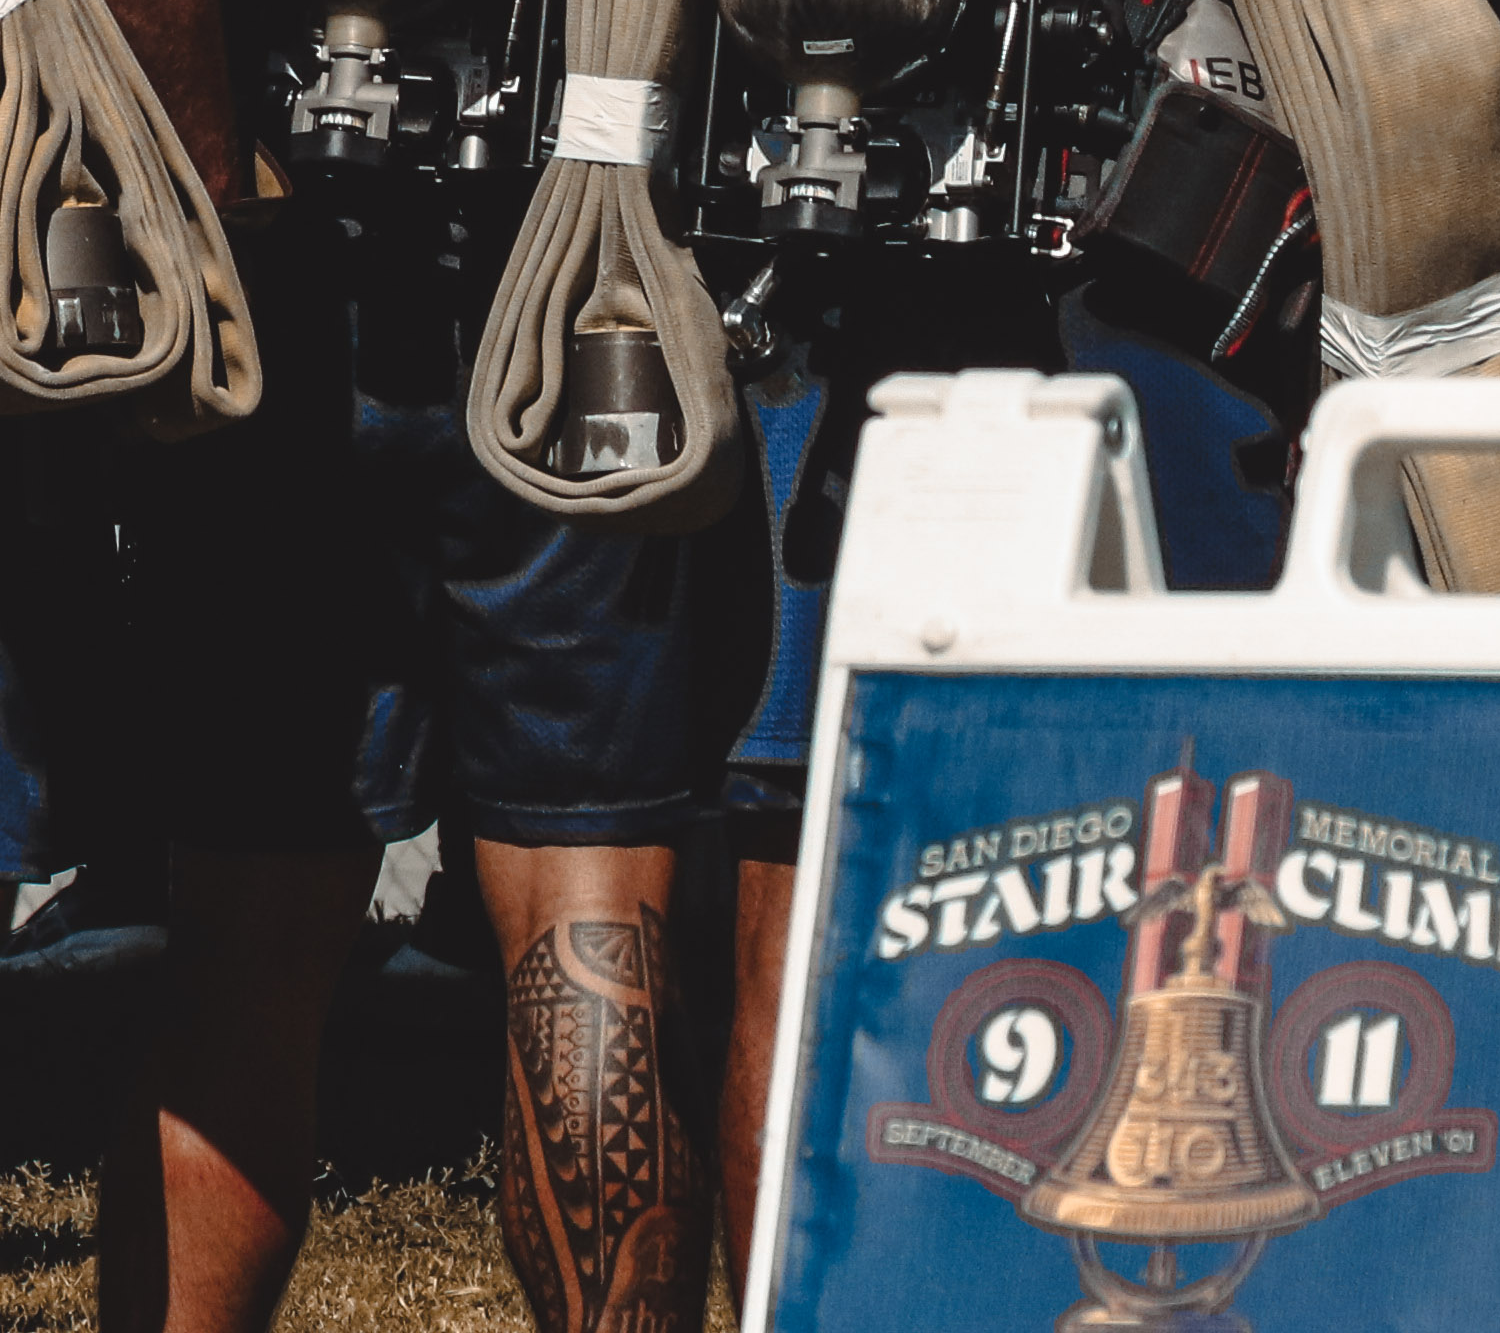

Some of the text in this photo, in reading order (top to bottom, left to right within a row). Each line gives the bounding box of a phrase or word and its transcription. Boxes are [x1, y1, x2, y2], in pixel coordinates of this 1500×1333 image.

[918, 831, 1001, 882] SAN
[1008, 805, 1136, 860] DIEGO
[877, 844, 1140, 961] STAIR
[981, 1007, 1402, 1108] 9 11
[882, 1120, 1039, 1187] SEPTEMBER
[1314, 1132, 1435, 1191] ELEVEN
